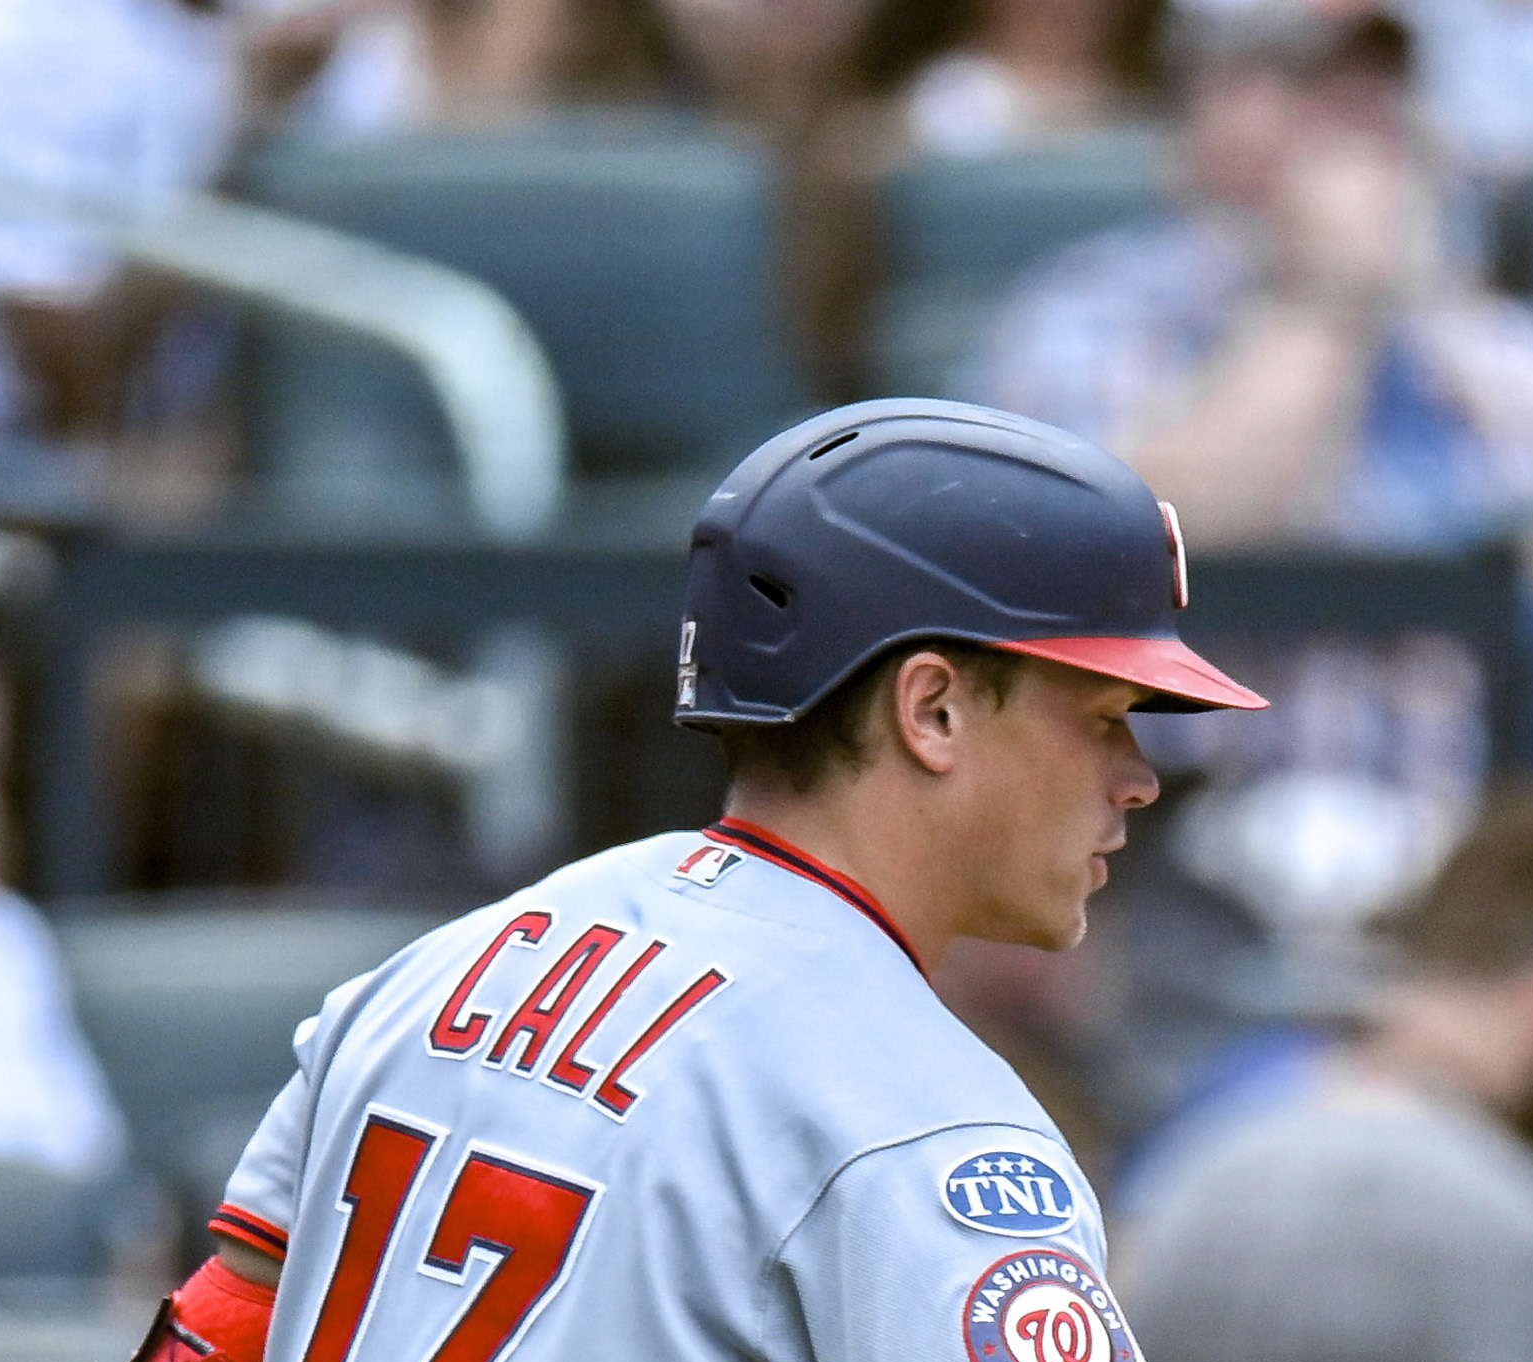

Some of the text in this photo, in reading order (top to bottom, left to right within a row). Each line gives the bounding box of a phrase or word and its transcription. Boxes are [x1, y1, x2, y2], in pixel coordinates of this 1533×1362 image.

[424, 906, 734, 1124] CALL
[948, 1174, 1074, 1220] TNL
[971, 1257, 1124, 1330] WASHINGTON
